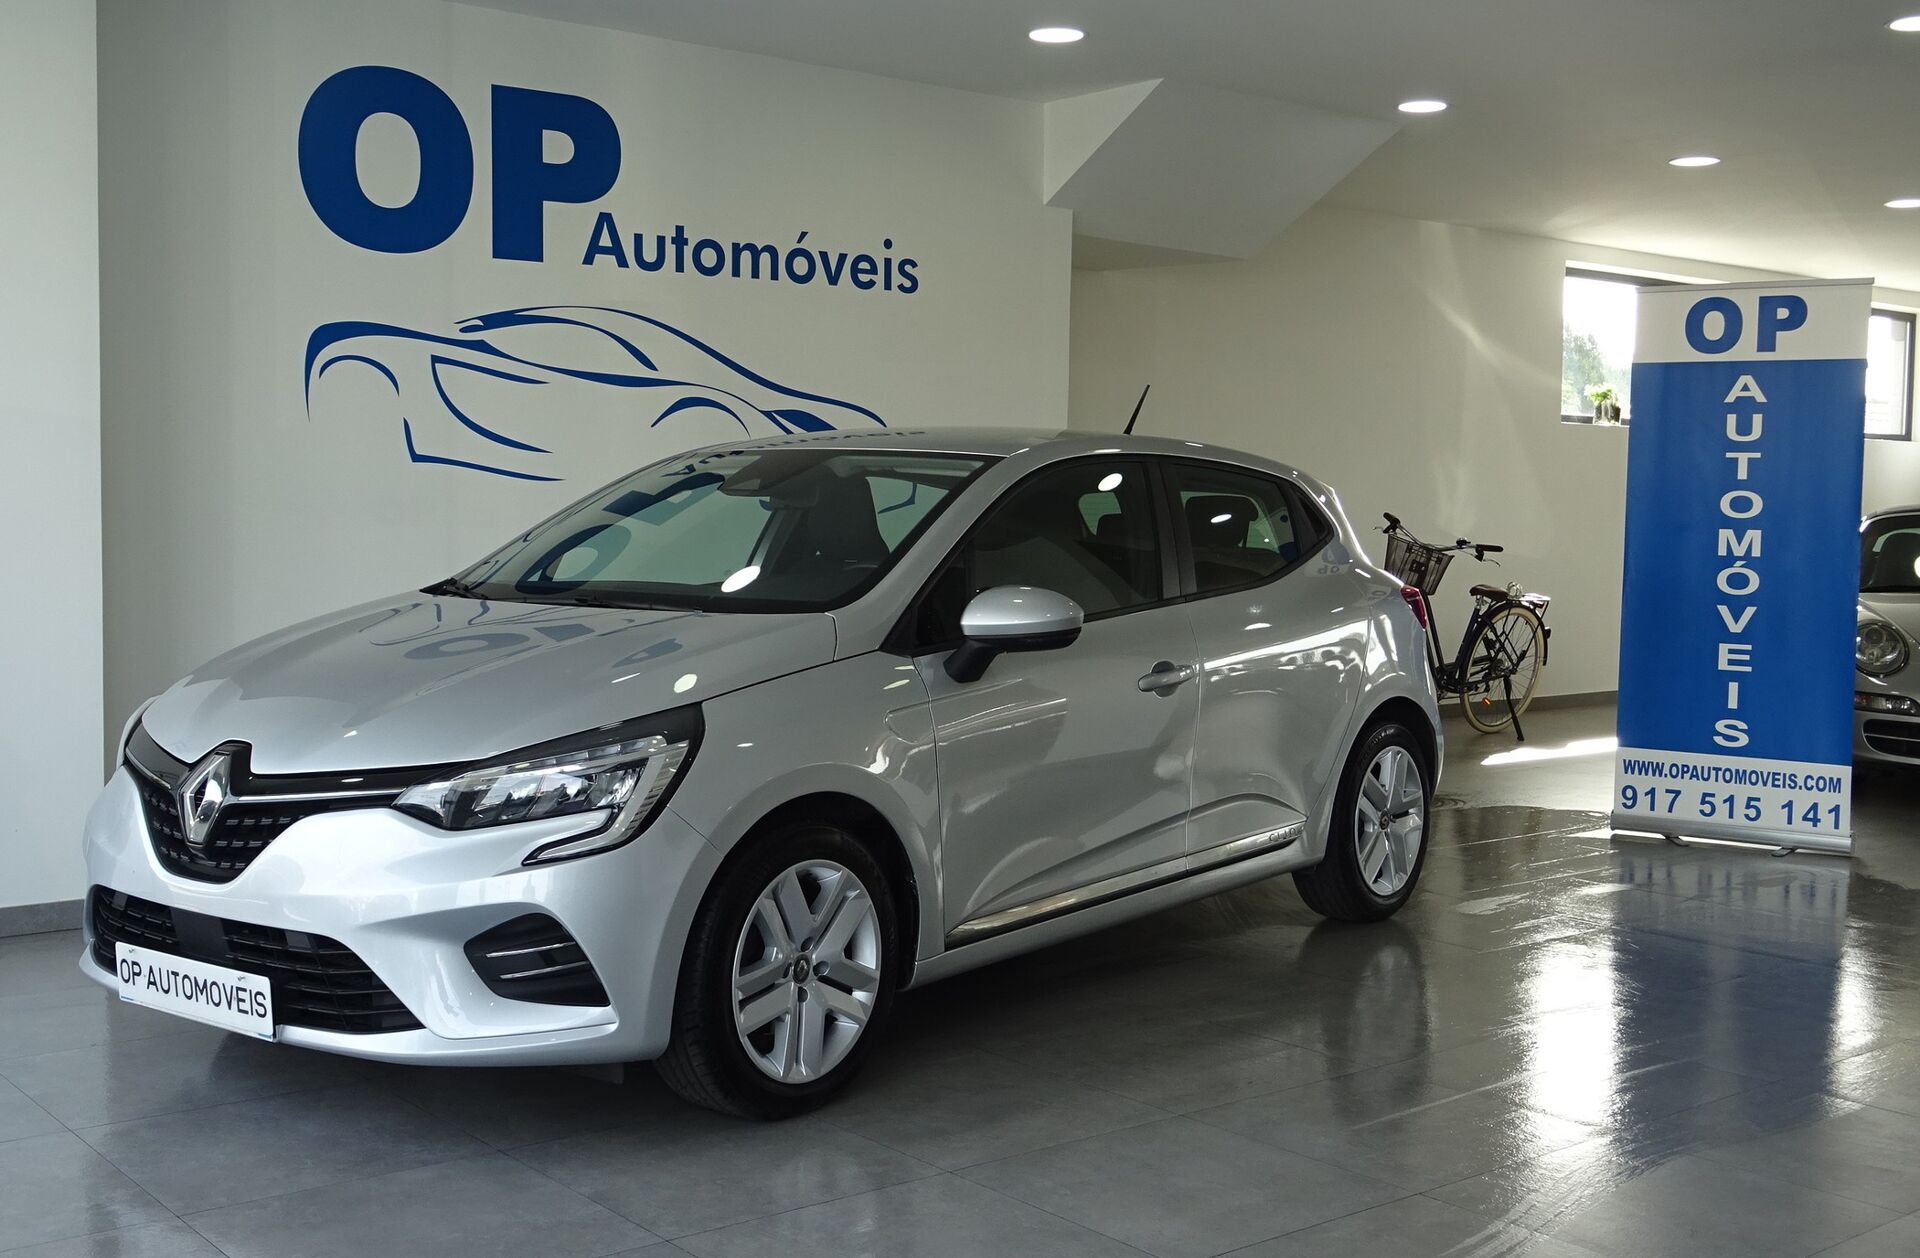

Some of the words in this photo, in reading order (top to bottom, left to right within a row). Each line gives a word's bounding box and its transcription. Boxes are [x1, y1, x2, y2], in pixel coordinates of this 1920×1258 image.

[298, 65, 621, 262] OP
[582, 212, 918, 294] Automóveis
[1685, 295, 1808, 354] OP
[1713, 374, 1767, 748] AUTOMÓVEIS
[1622, 758, 1842, 793] WWW.OPAUTOMOVEIS.COM
[1621, 785, 1682, 813] 917
[1699, 792, 1762, 822] 515
[1781, 799, 1841, 830] 141
[120, 958, 142, 986] OP
[146, 966, 268, 1019] AUTOMOVEIS
